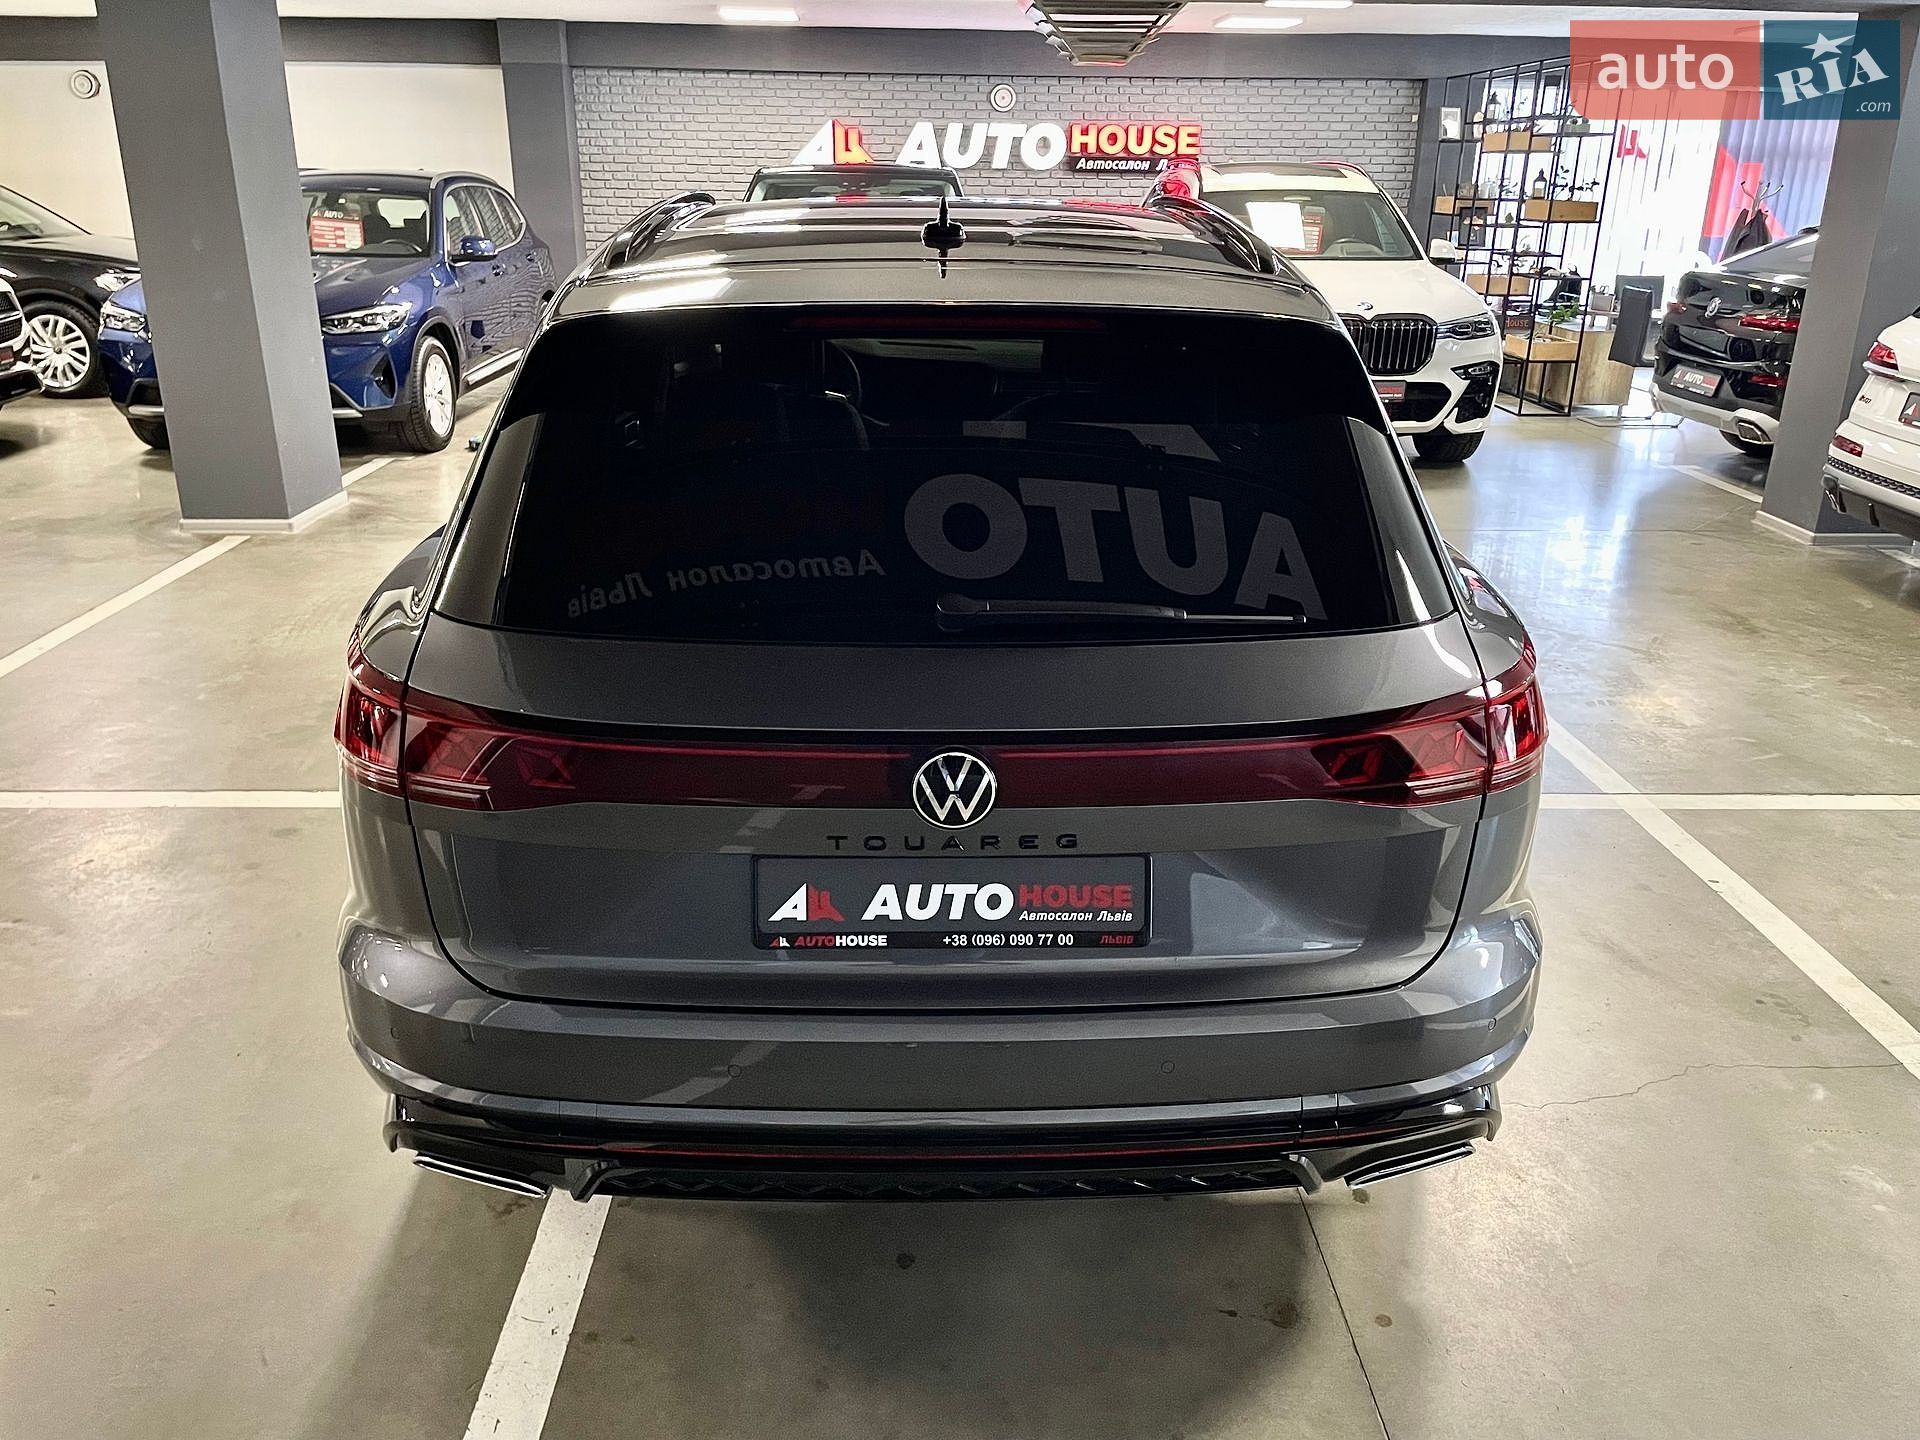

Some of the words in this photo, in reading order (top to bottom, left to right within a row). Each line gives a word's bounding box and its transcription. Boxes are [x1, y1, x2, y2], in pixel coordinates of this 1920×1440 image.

[895, 121, 1067, 170] AUTO
[1068, 123, 1200, 156] HOUSE
[1076, 158, 1150, 170] Автосалон
[1683, 372, 1703, 384] AUTO
[827, 833, 1078, 851] TOUAREG
[861, 882, 1014, 921] AUTO
[1019, 884, 1133, 908] HOUSE
[1019, 910, 1093, 921] Автосалон
[1097, 910, 1133, 921] Львів
[795, 935, 887, 947] AUTOHOUSE
[943, 934, 967, 946] +38
[971, 934, 1005, 947] (096)
[1009, 934, 1034, 946] 090
[1037, 934, 1054, 946] 77
[1057, 934, 1074, 946] 00
